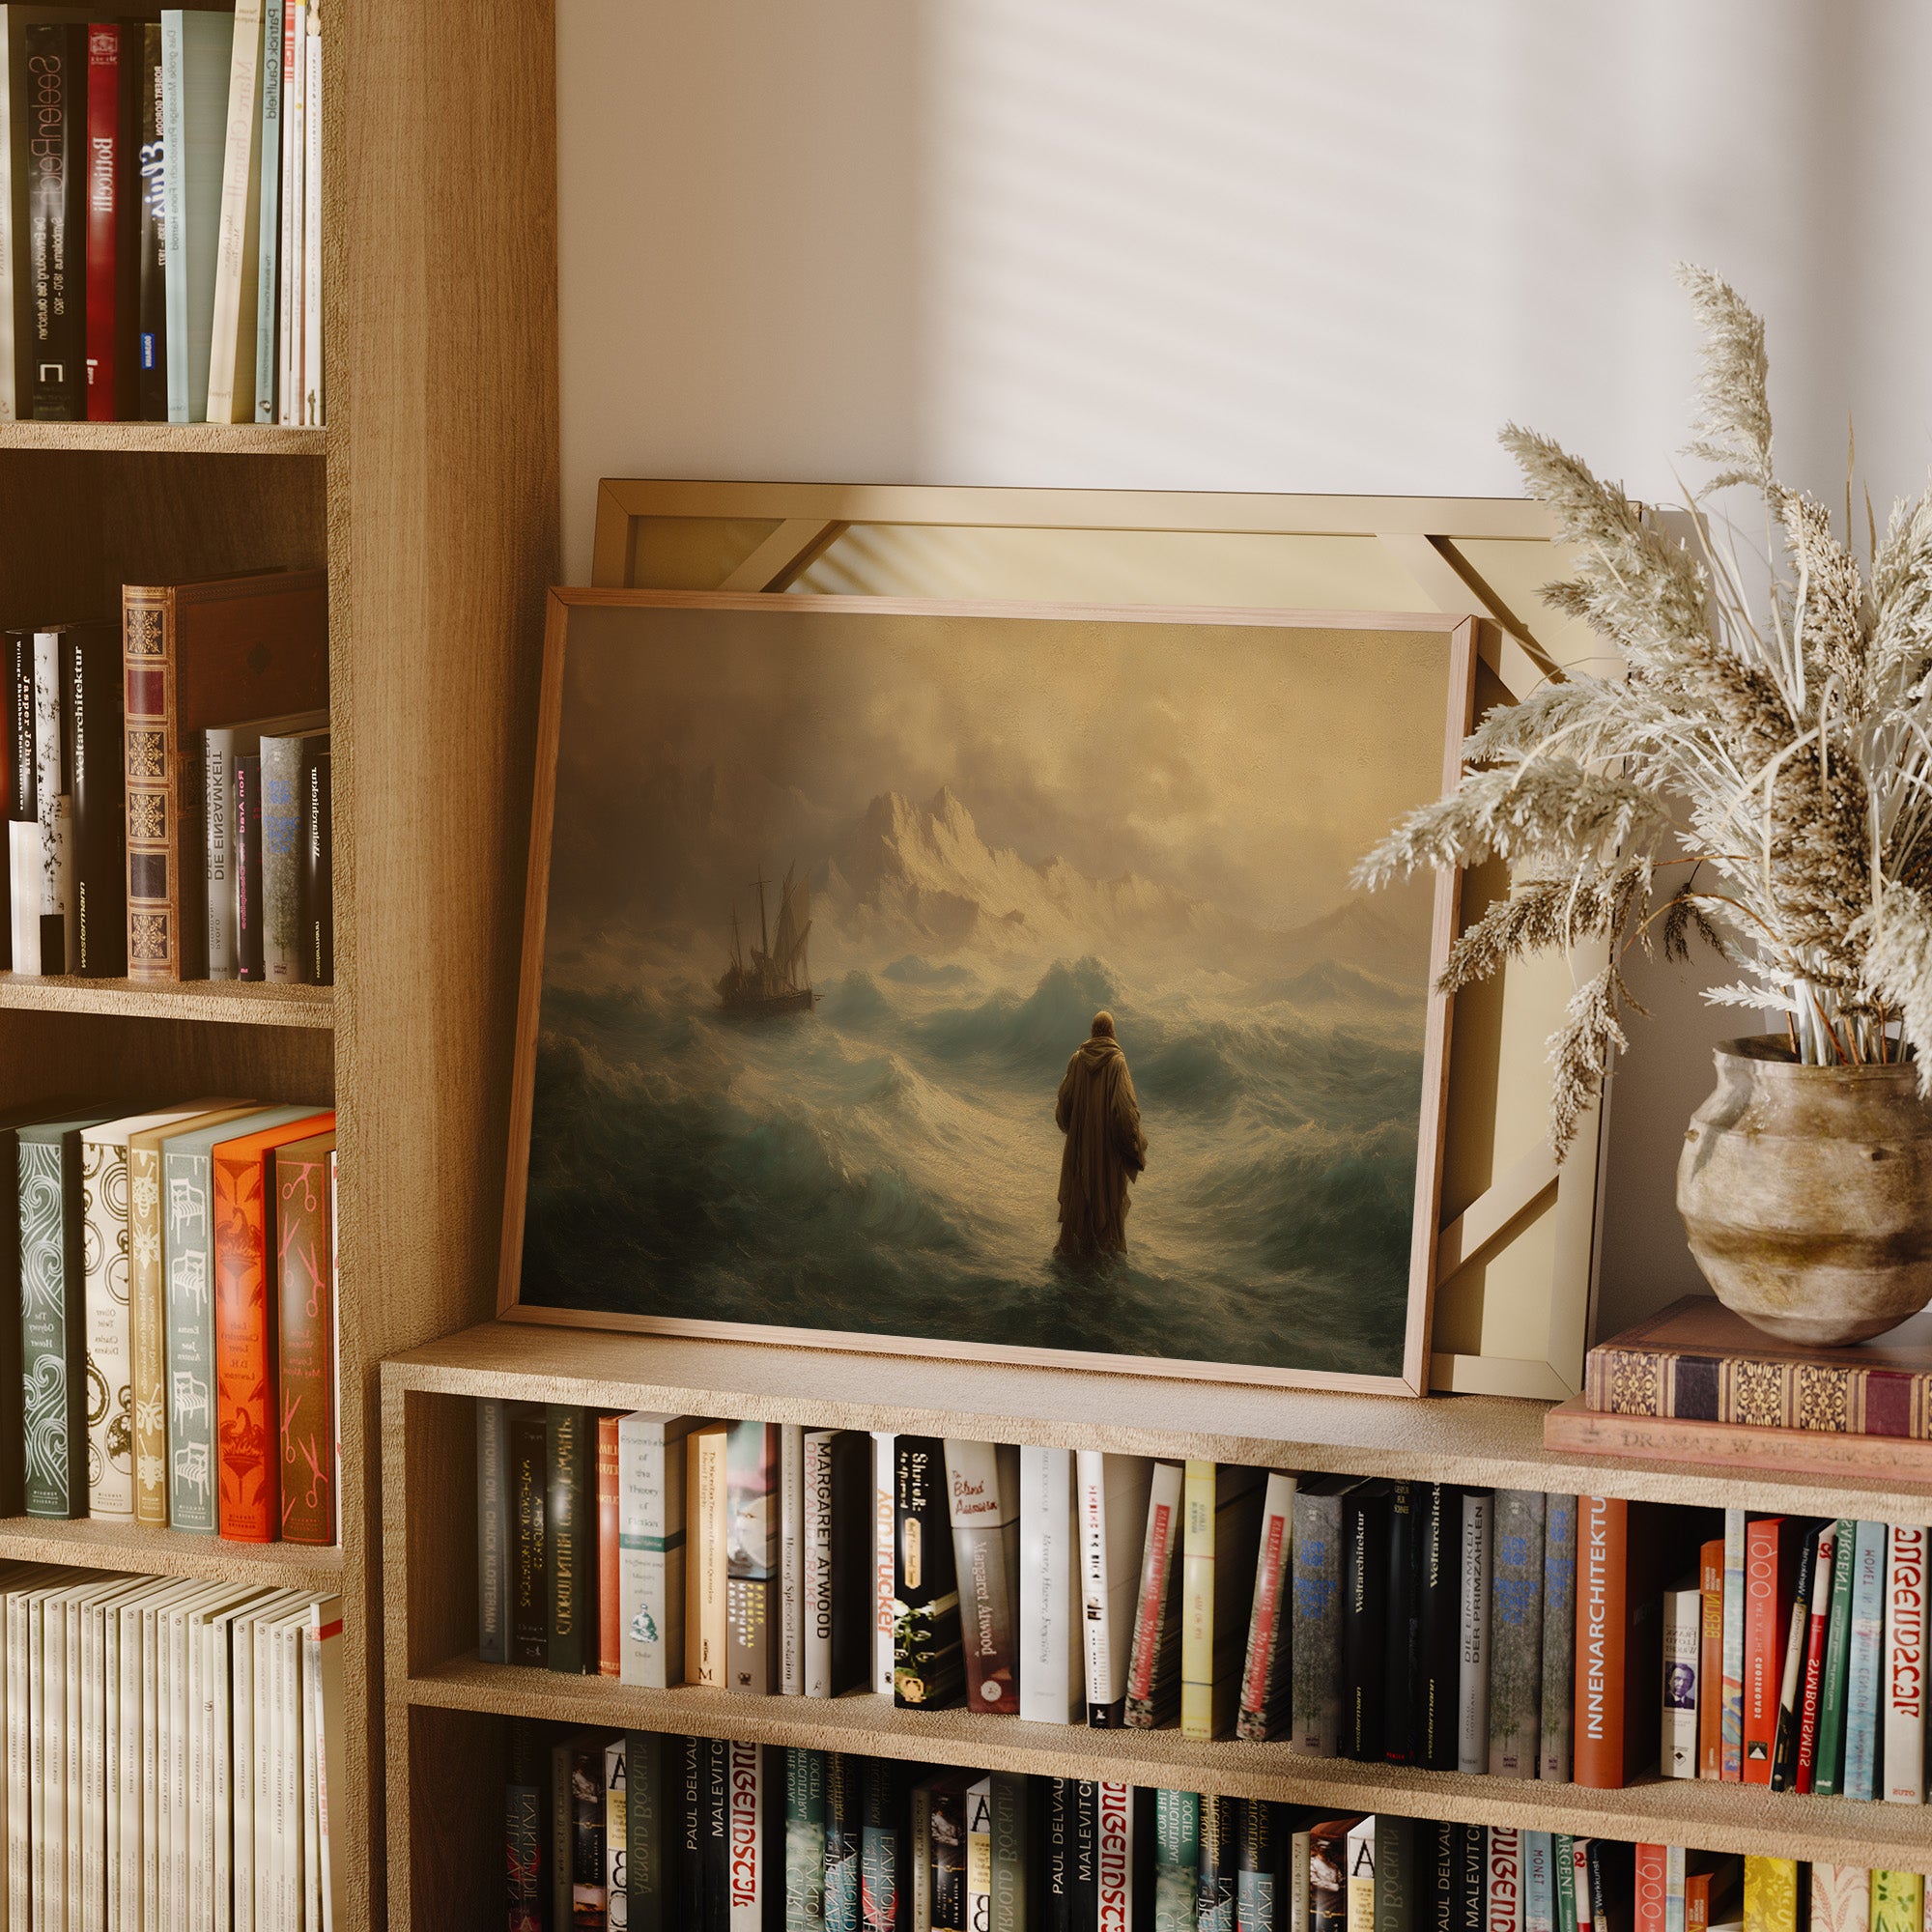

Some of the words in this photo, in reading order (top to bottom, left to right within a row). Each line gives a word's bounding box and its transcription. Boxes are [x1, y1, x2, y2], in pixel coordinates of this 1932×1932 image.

[21, 675, 31, 726] Jasper
[73, 645, 85, 783] Weltarchitektur
[23, 730, 32, 776] Johns
[78, 881, 88, 969] westermann
[484, 1405, 497, 1477] DOWNTOWN
[1621, 1432, 1719, 1453] DRAMAT
[1732, 1437, 1753, 1454] W
[629, 1484, 659, 1496] Theory
[635, 1469, 651, 1478] the
[805, 1441, 816, 1492] ORYX
[953, 1480, 984, 1497] Blind
[485, 1478, 497, 1505] OWL
[639, 1502, 648, 1511] of
[816, 1442, 831, 1548] MARGARET
[484, 1510, 497, 1552] CHUCK
[805, 1498, 816, 1540] AND
[805, 1548, 815, 1612] CRAKE
[972, 1541, 990, 1600] Margaret
[1355, 1510, 1365, 1614] Weltarchitektur
[1463, 1520, 1474, 1630] EINSAMKEIT
[1472, 1505, 1483, 1622] PRIMZAHLEN
[484, 1554, 496, 1633] KLOSTERMAN
[816, 1557, 831, 1639] ATWOOD
[979, 1605, 998, 1657] Atwood
[1472, 1627, 1481, 1664] DER
[697, 1665, 713, 1681] M
[1426, 1678, 1435, 1759] westermann
[686, 1807, 697, 1850] PAUL
[1052, 1851, 1064, 1894] PAUL
[1533, 1849, 1545, 1886] MONET
[1592, 1861, 1603, 1907] Werkkunst
[1635, 1856, 1663, 1919] 1900
[1533, 1890, 1545, 1903] IN
